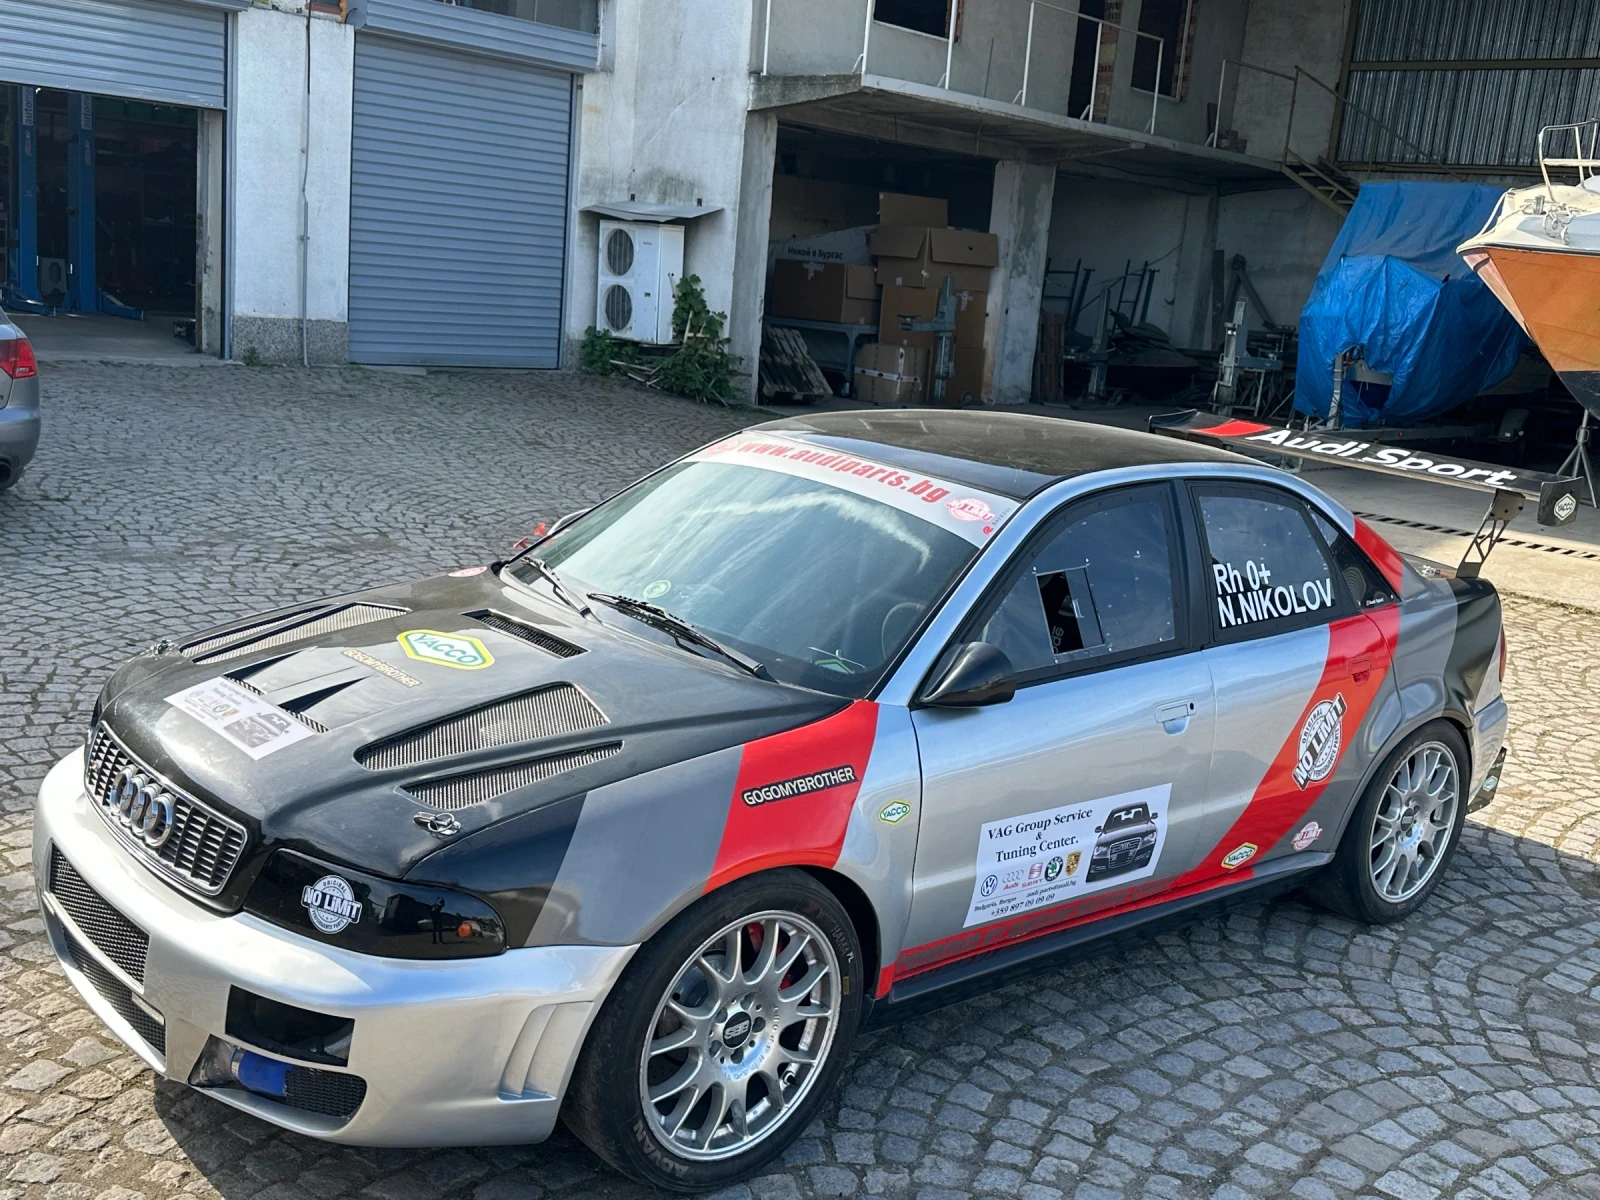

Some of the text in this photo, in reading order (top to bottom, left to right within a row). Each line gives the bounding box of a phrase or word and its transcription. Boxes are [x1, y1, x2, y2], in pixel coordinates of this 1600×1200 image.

[818, 249, 843, 260] Бургас
[737, 441, 951, 503] www.audiparts.bg
[1245, 429, 1518, 486] Audi Sport
[1212, 562, 1243, 595] Rh
[1217, 577, 1332, 628] N.NIKOLOV
[413, 634, 479, 664] YACCO
[343, 650, 421, 687] GOGOMYBROTHER
[1302, 708, 1323, 744] ORIGINAL
[1293, 753, 1313, 786] NO
[743, 767, 855, 805] GOGOMYBROTHER
[883, 805, 908, 818] YACCO
[988, 809, 1093, 840] VAG Group Service
[996, 835, 1079, 863] Tuning Center.
[1036, 832, 1042, 840] &
[1228, 849, 1252, 862] YACCO
[304, 887, 322, 905] NO
[323, 880, 347, 893] ORIGINAL
[1021, 879, 1043, 888] SEAT
[991, 893, 1056, 917] +359 897 09 09 09
[723, 1019, 750, 1041] BBS
[633, 1119, 689, 1178] ADVAN
